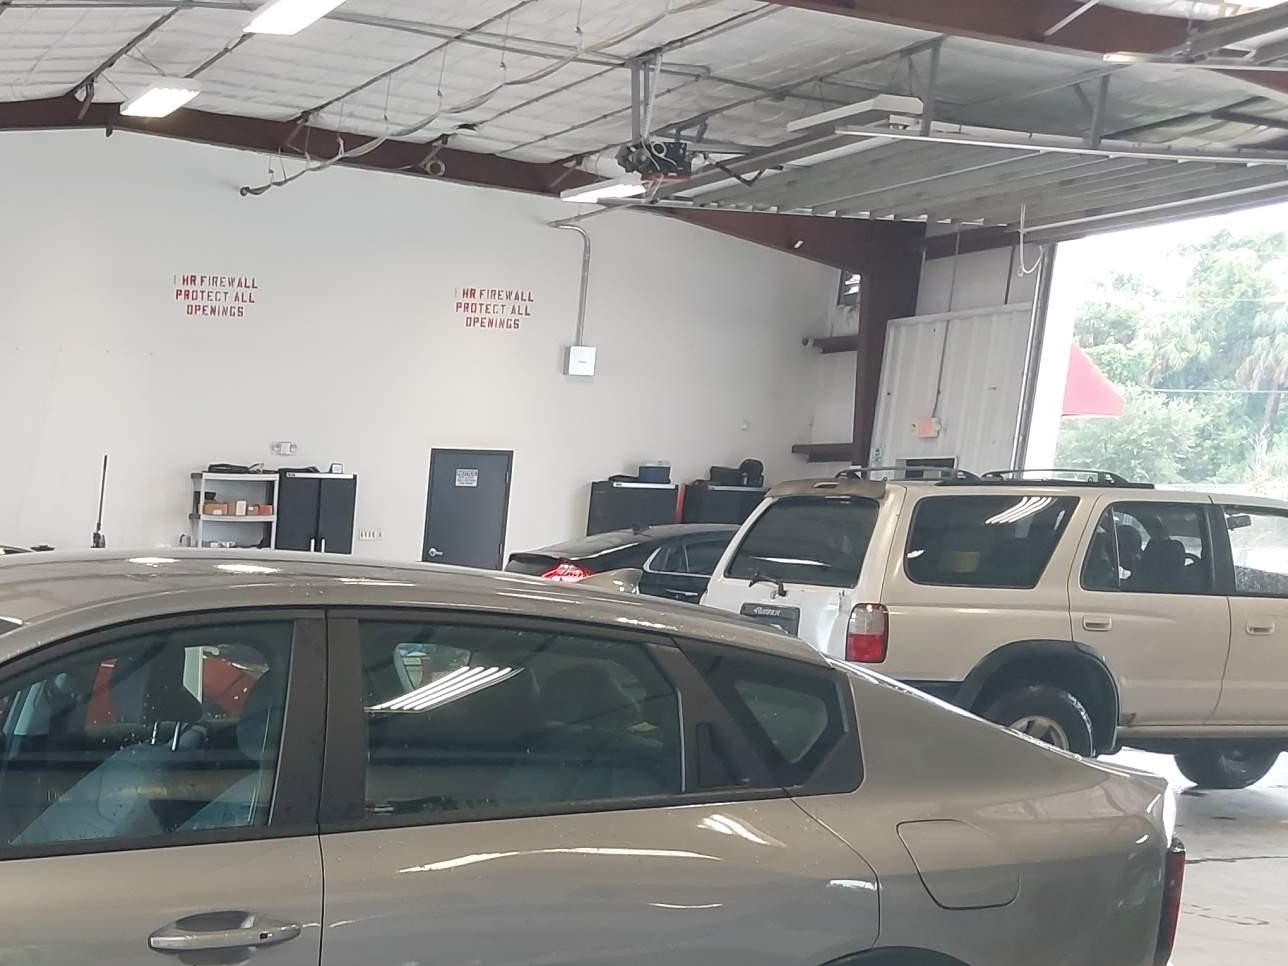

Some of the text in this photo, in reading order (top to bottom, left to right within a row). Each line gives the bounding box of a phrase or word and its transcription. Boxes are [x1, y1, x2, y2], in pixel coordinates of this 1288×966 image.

[182, 274, 197, 286] HR
[200, 275, 258, 289] FIREWALL
[175, 289, 255, 303] PROTECT ALL
[462, 288, 476, 299] HR
[479, 289, 534, 302] FIREWALL
[186, 304, 244, 317] OPENINGS
[455, 302, 531, 316] PROTECT ALL
[465, 316, 520, 329] OPENINGS
